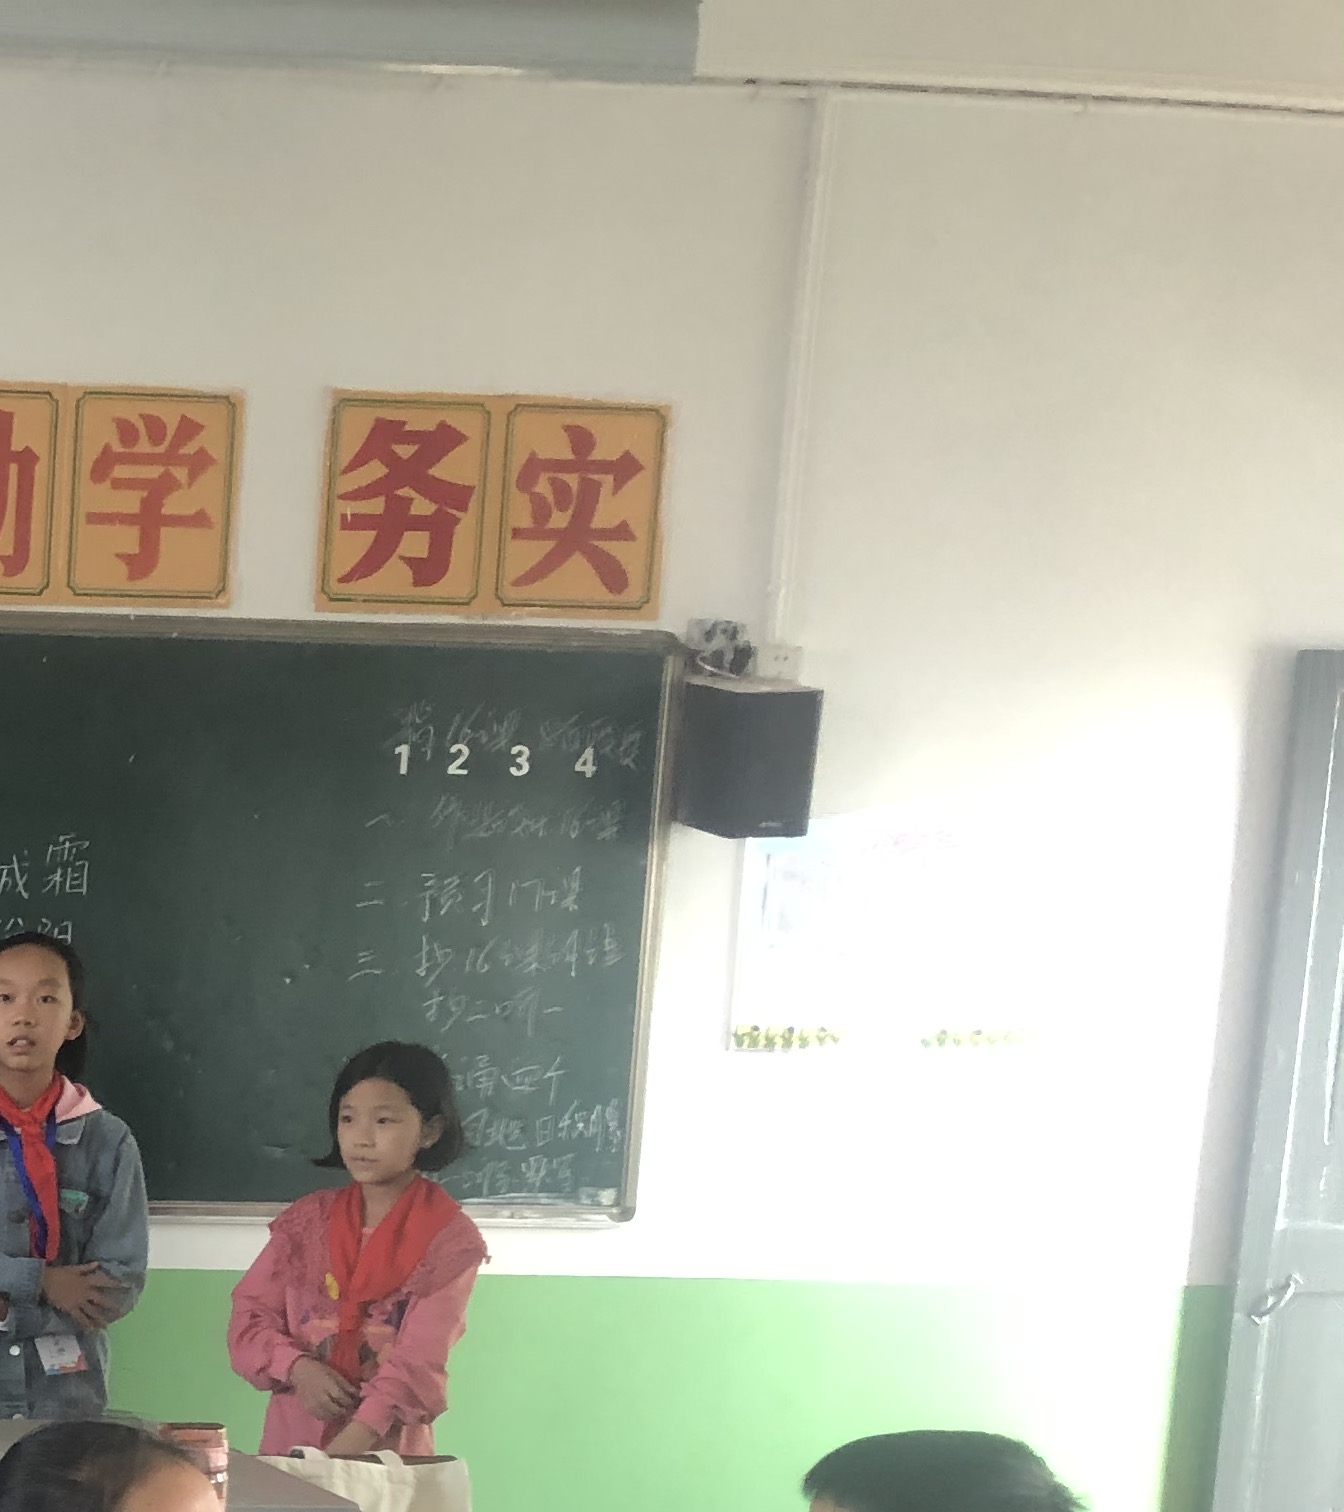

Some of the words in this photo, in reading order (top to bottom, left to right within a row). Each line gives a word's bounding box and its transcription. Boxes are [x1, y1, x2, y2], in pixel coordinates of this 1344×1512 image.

[335, 417, 648, 597] 务实
[393, 743, 411, 776] 1
[446, 743, 470, 776] 2
[508, 743, 531, 777] 3
[574, 745, 597, 779] 4
